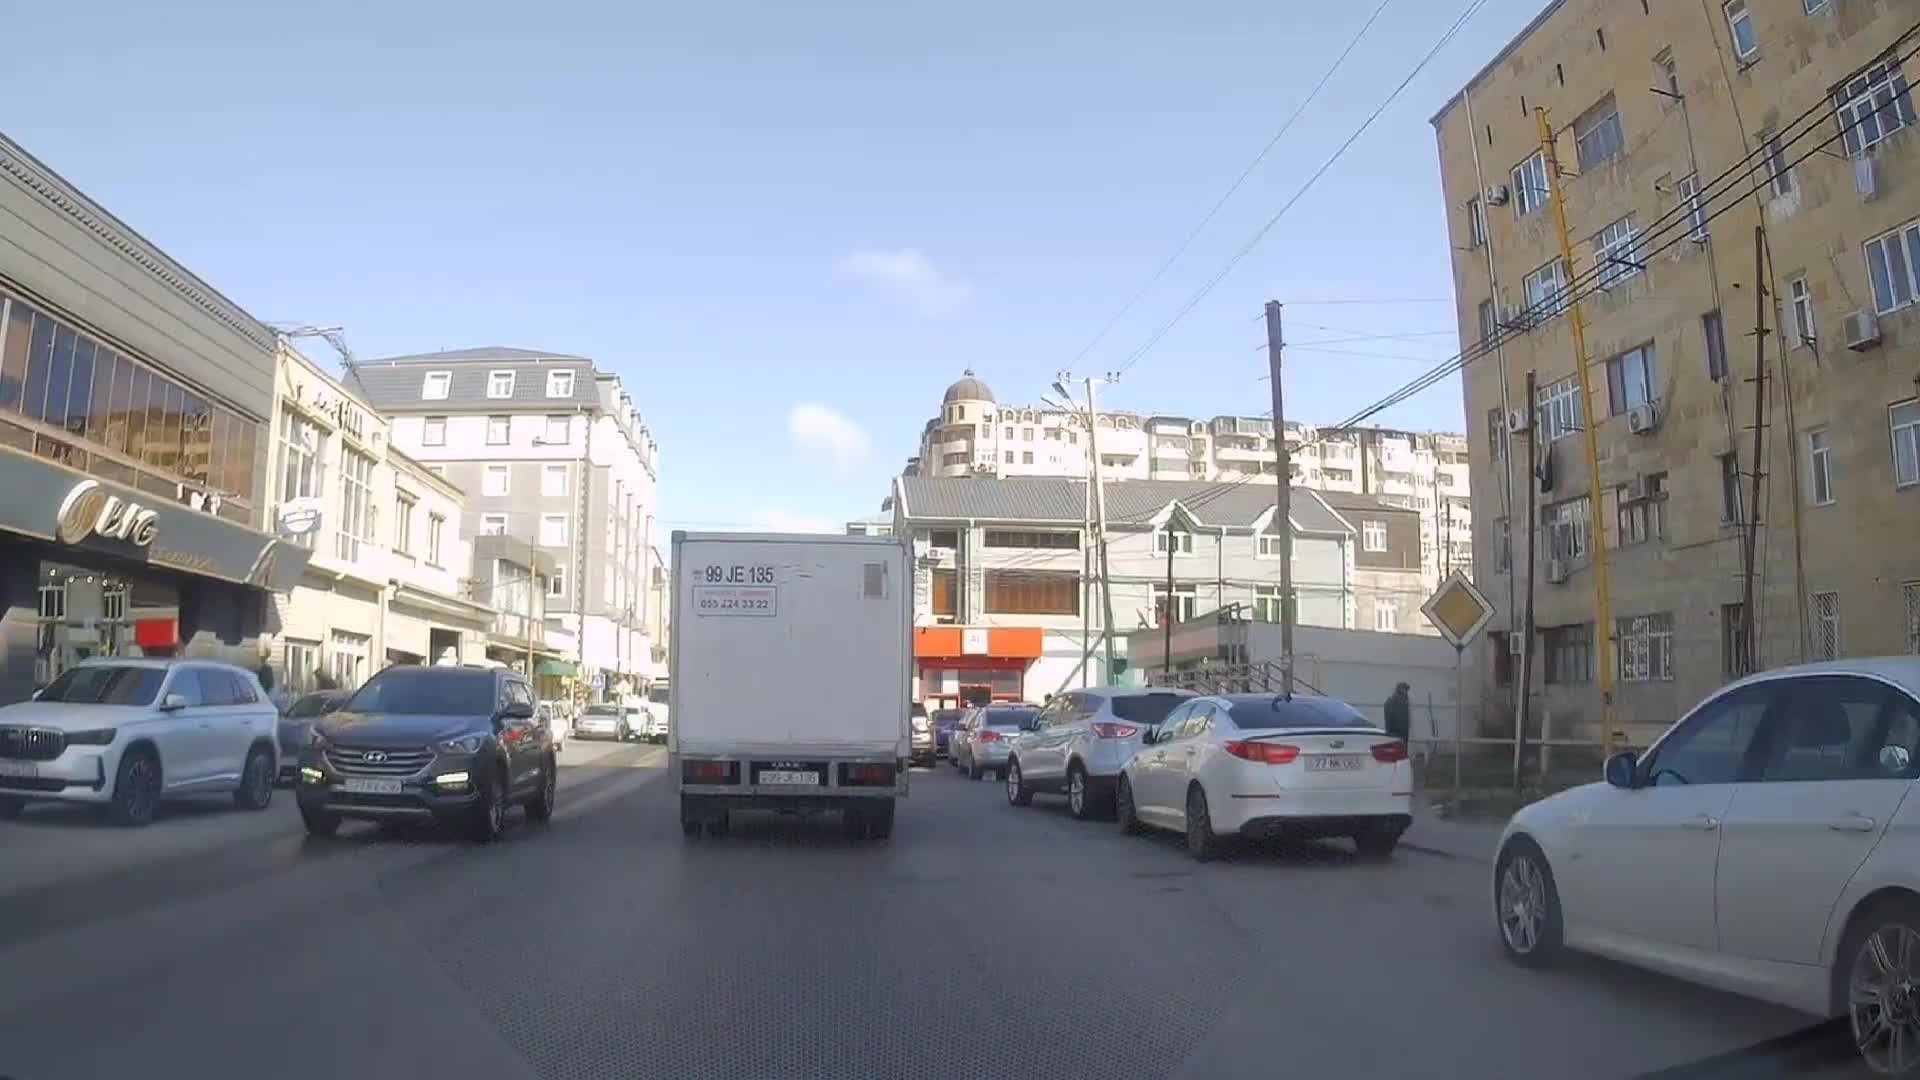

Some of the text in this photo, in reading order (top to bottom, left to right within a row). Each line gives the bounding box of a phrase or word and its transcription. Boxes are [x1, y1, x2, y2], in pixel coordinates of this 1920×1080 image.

[96, 496, 159, 546] BIG
[705, 565, 723, 583] 99
[726, 565, 745, 583] JE
[749, 566, 774, 583] 135
[756, 599, 769, 609] 22
